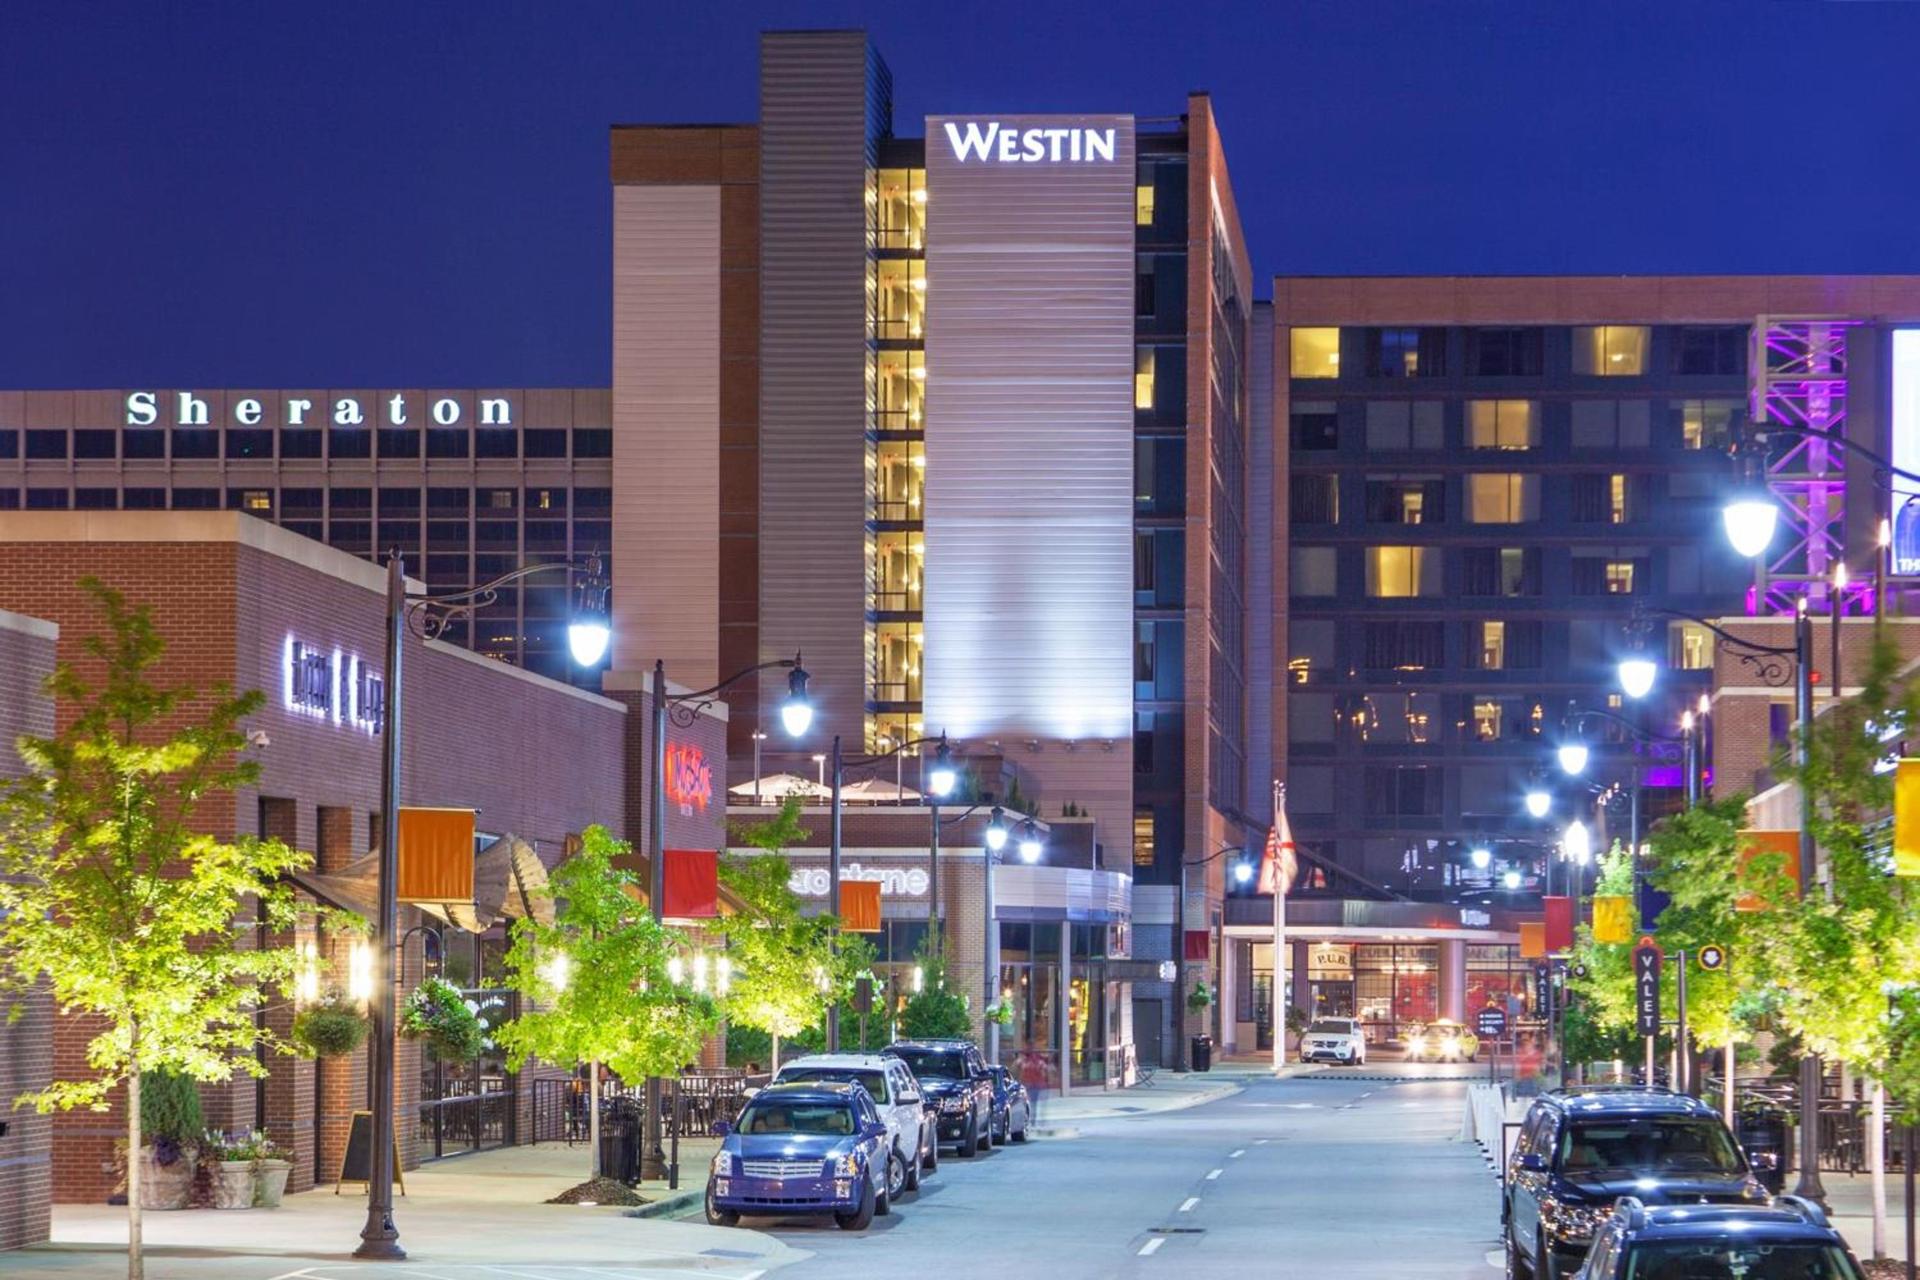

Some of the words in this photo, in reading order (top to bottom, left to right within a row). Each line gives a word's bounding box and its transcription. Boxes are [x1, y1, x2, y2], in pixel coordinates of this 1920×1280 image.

[944, 122, 1116, 162] WESTIN
[127, 392, 512, 425] Sheraton
[1538, 968, 1547, 1013] VALET
[1640, 956, 1654, 1028] VALET
